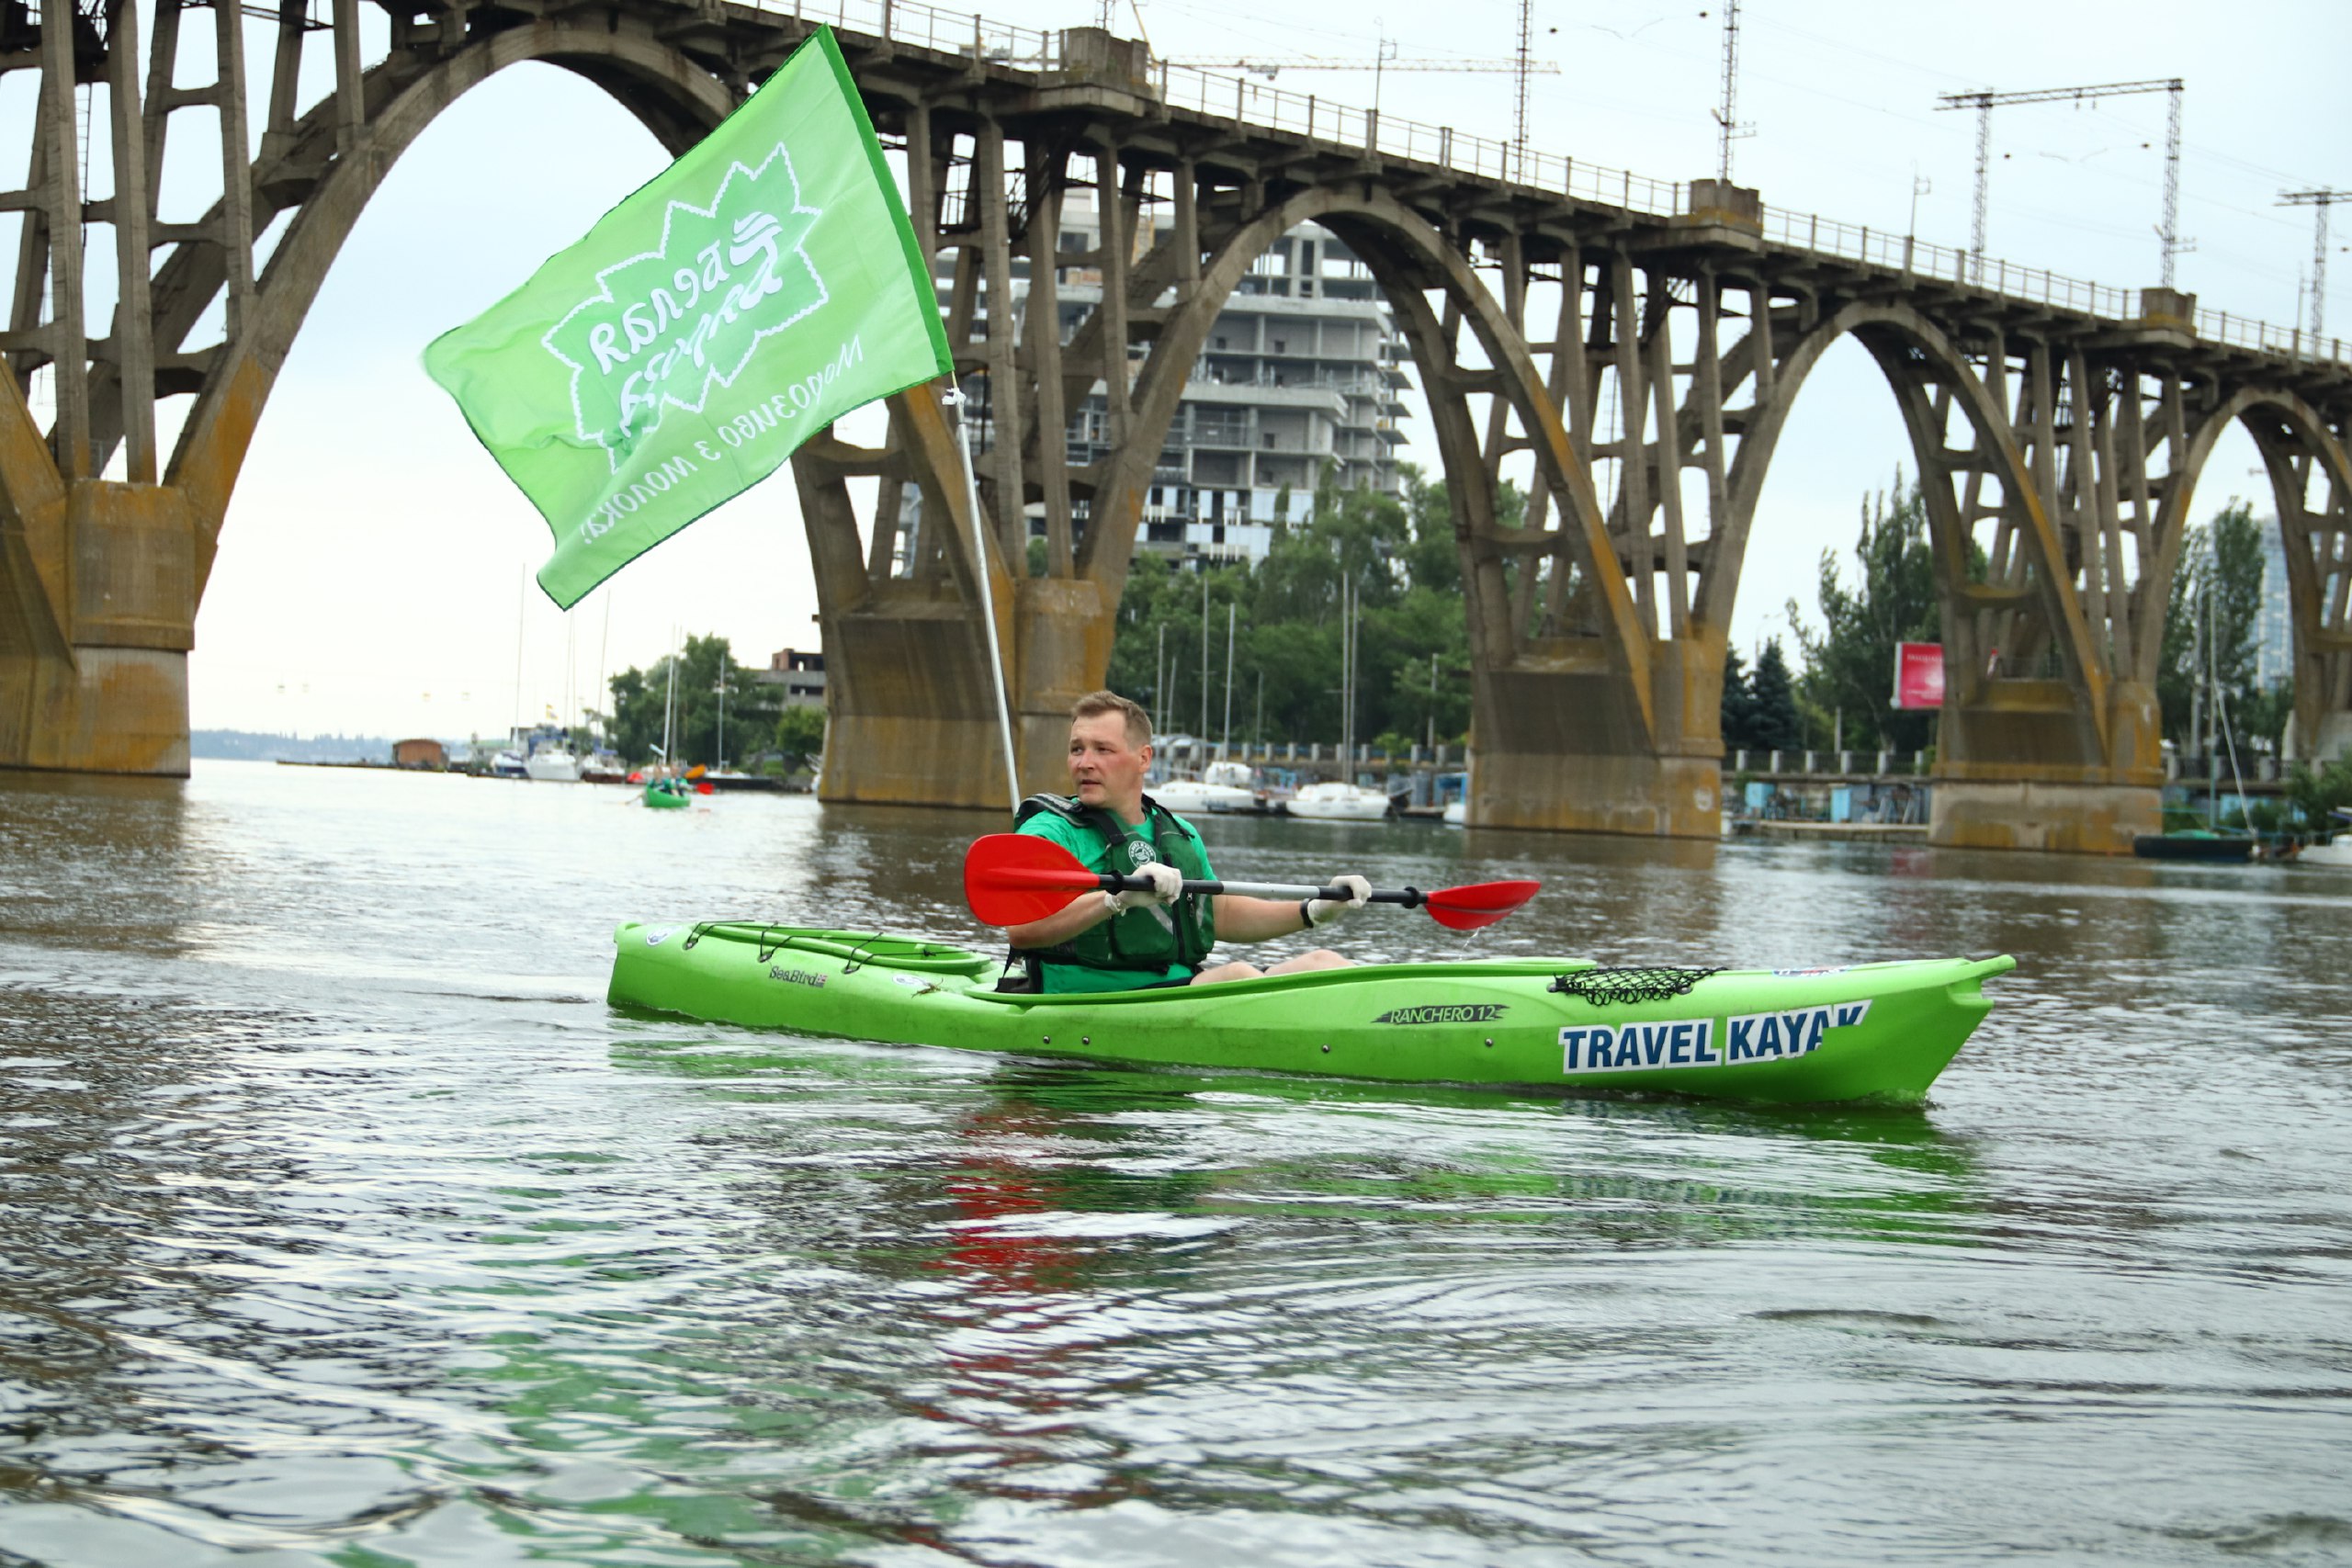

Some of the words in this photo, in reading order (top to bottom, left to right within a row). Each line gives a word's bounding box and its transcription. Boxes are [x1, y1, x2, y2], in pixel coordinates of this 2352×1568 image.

[769, 965, 819, 987] SeaBird
[1389, 1006, 1475, 1023] RANCHERO
[1477, 1005, 1497, 1021] 12
[1564, 1022, 1716, 1069] TRAVEL
